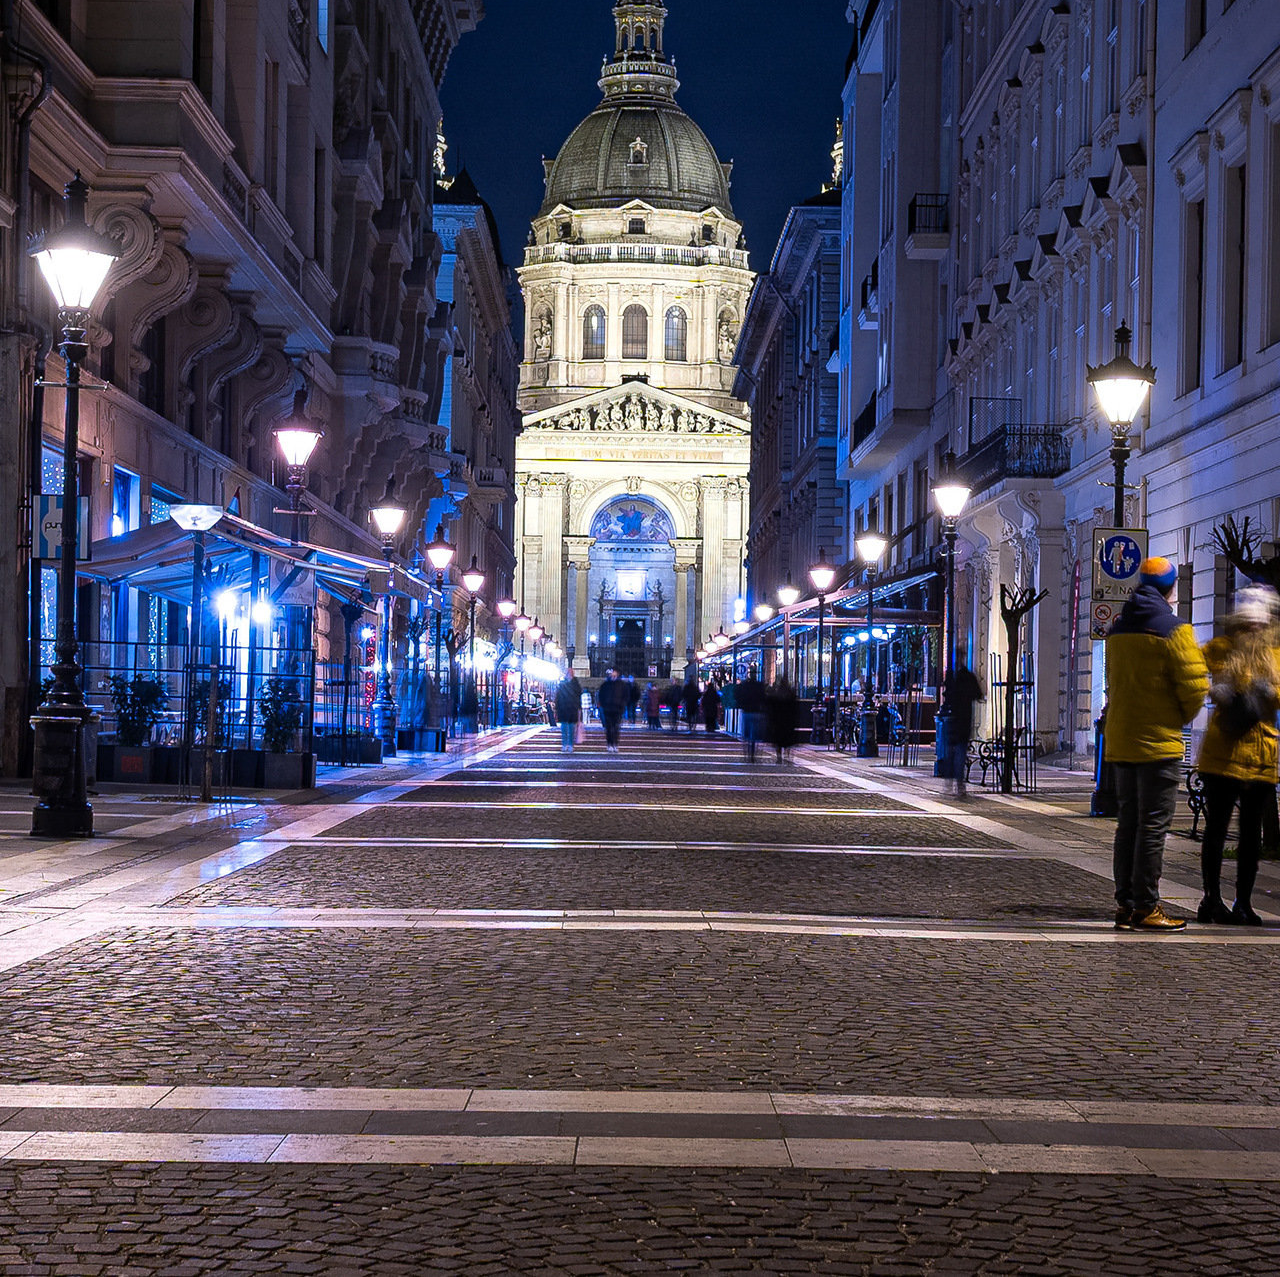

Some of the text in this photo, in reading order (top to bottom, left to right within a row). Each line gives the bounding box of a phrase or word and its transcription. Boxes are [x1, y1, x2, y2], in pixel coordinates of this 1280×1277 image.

[609, 450, 625, 459] VIA
[631, 450, 670, 460] VERITAS
[675, 451, 687, 460] ET
[1105, 585, 1133, 595] ZNA
